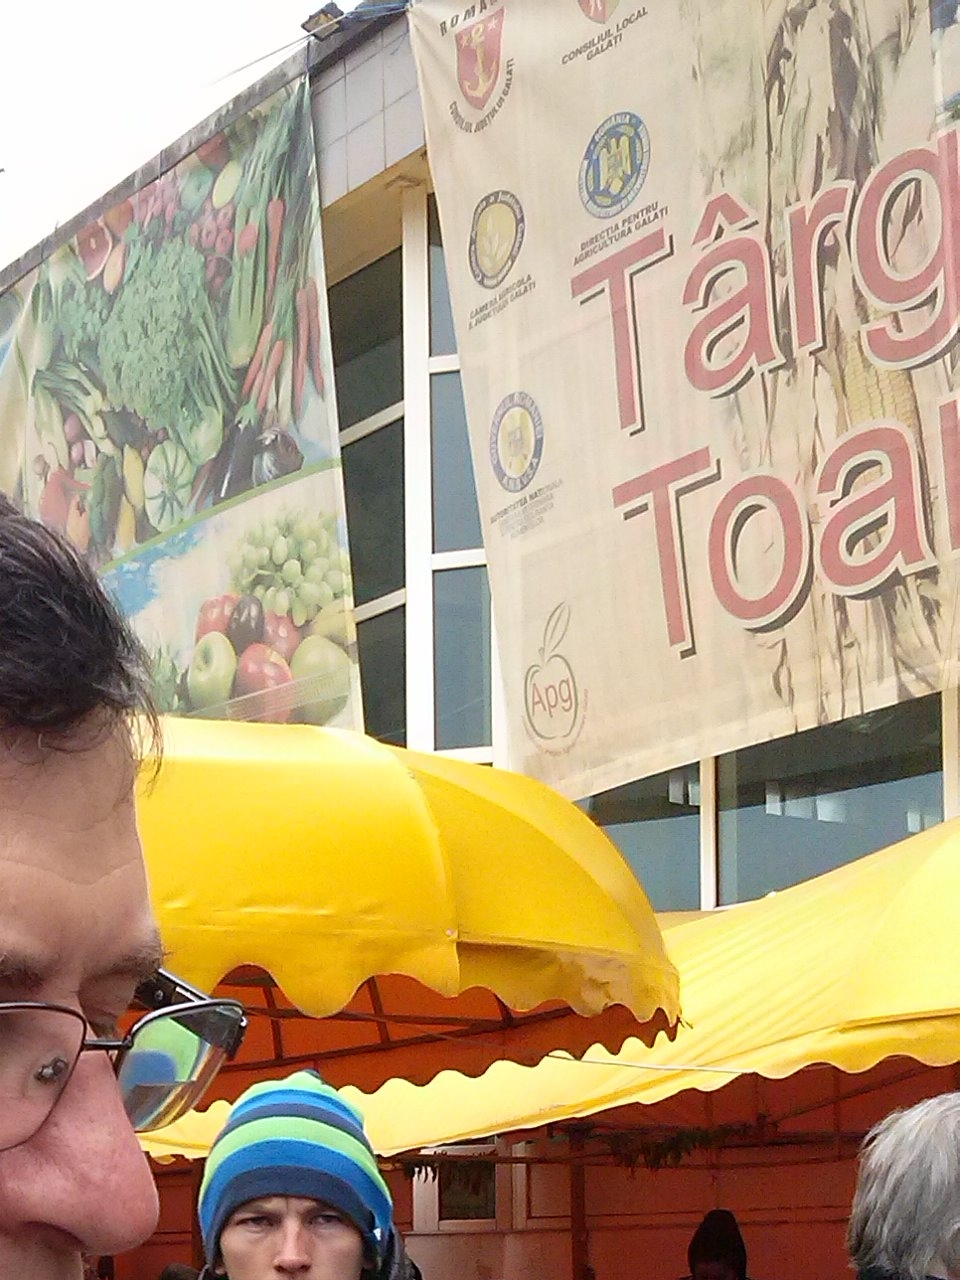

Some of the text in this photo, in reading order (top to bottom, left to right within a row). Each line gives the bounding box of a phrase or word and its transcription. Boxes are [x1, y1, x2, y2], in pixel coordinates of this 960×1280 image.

[561, 6, 648, 65] CONSILIUL LOCAL
[622, 201, 659, 228] PENTRU
[573, 226, 633, 267] AGRICULTURA
[612, 402, 960, 656] Toa
[531, 677, 573, 719] Apg
